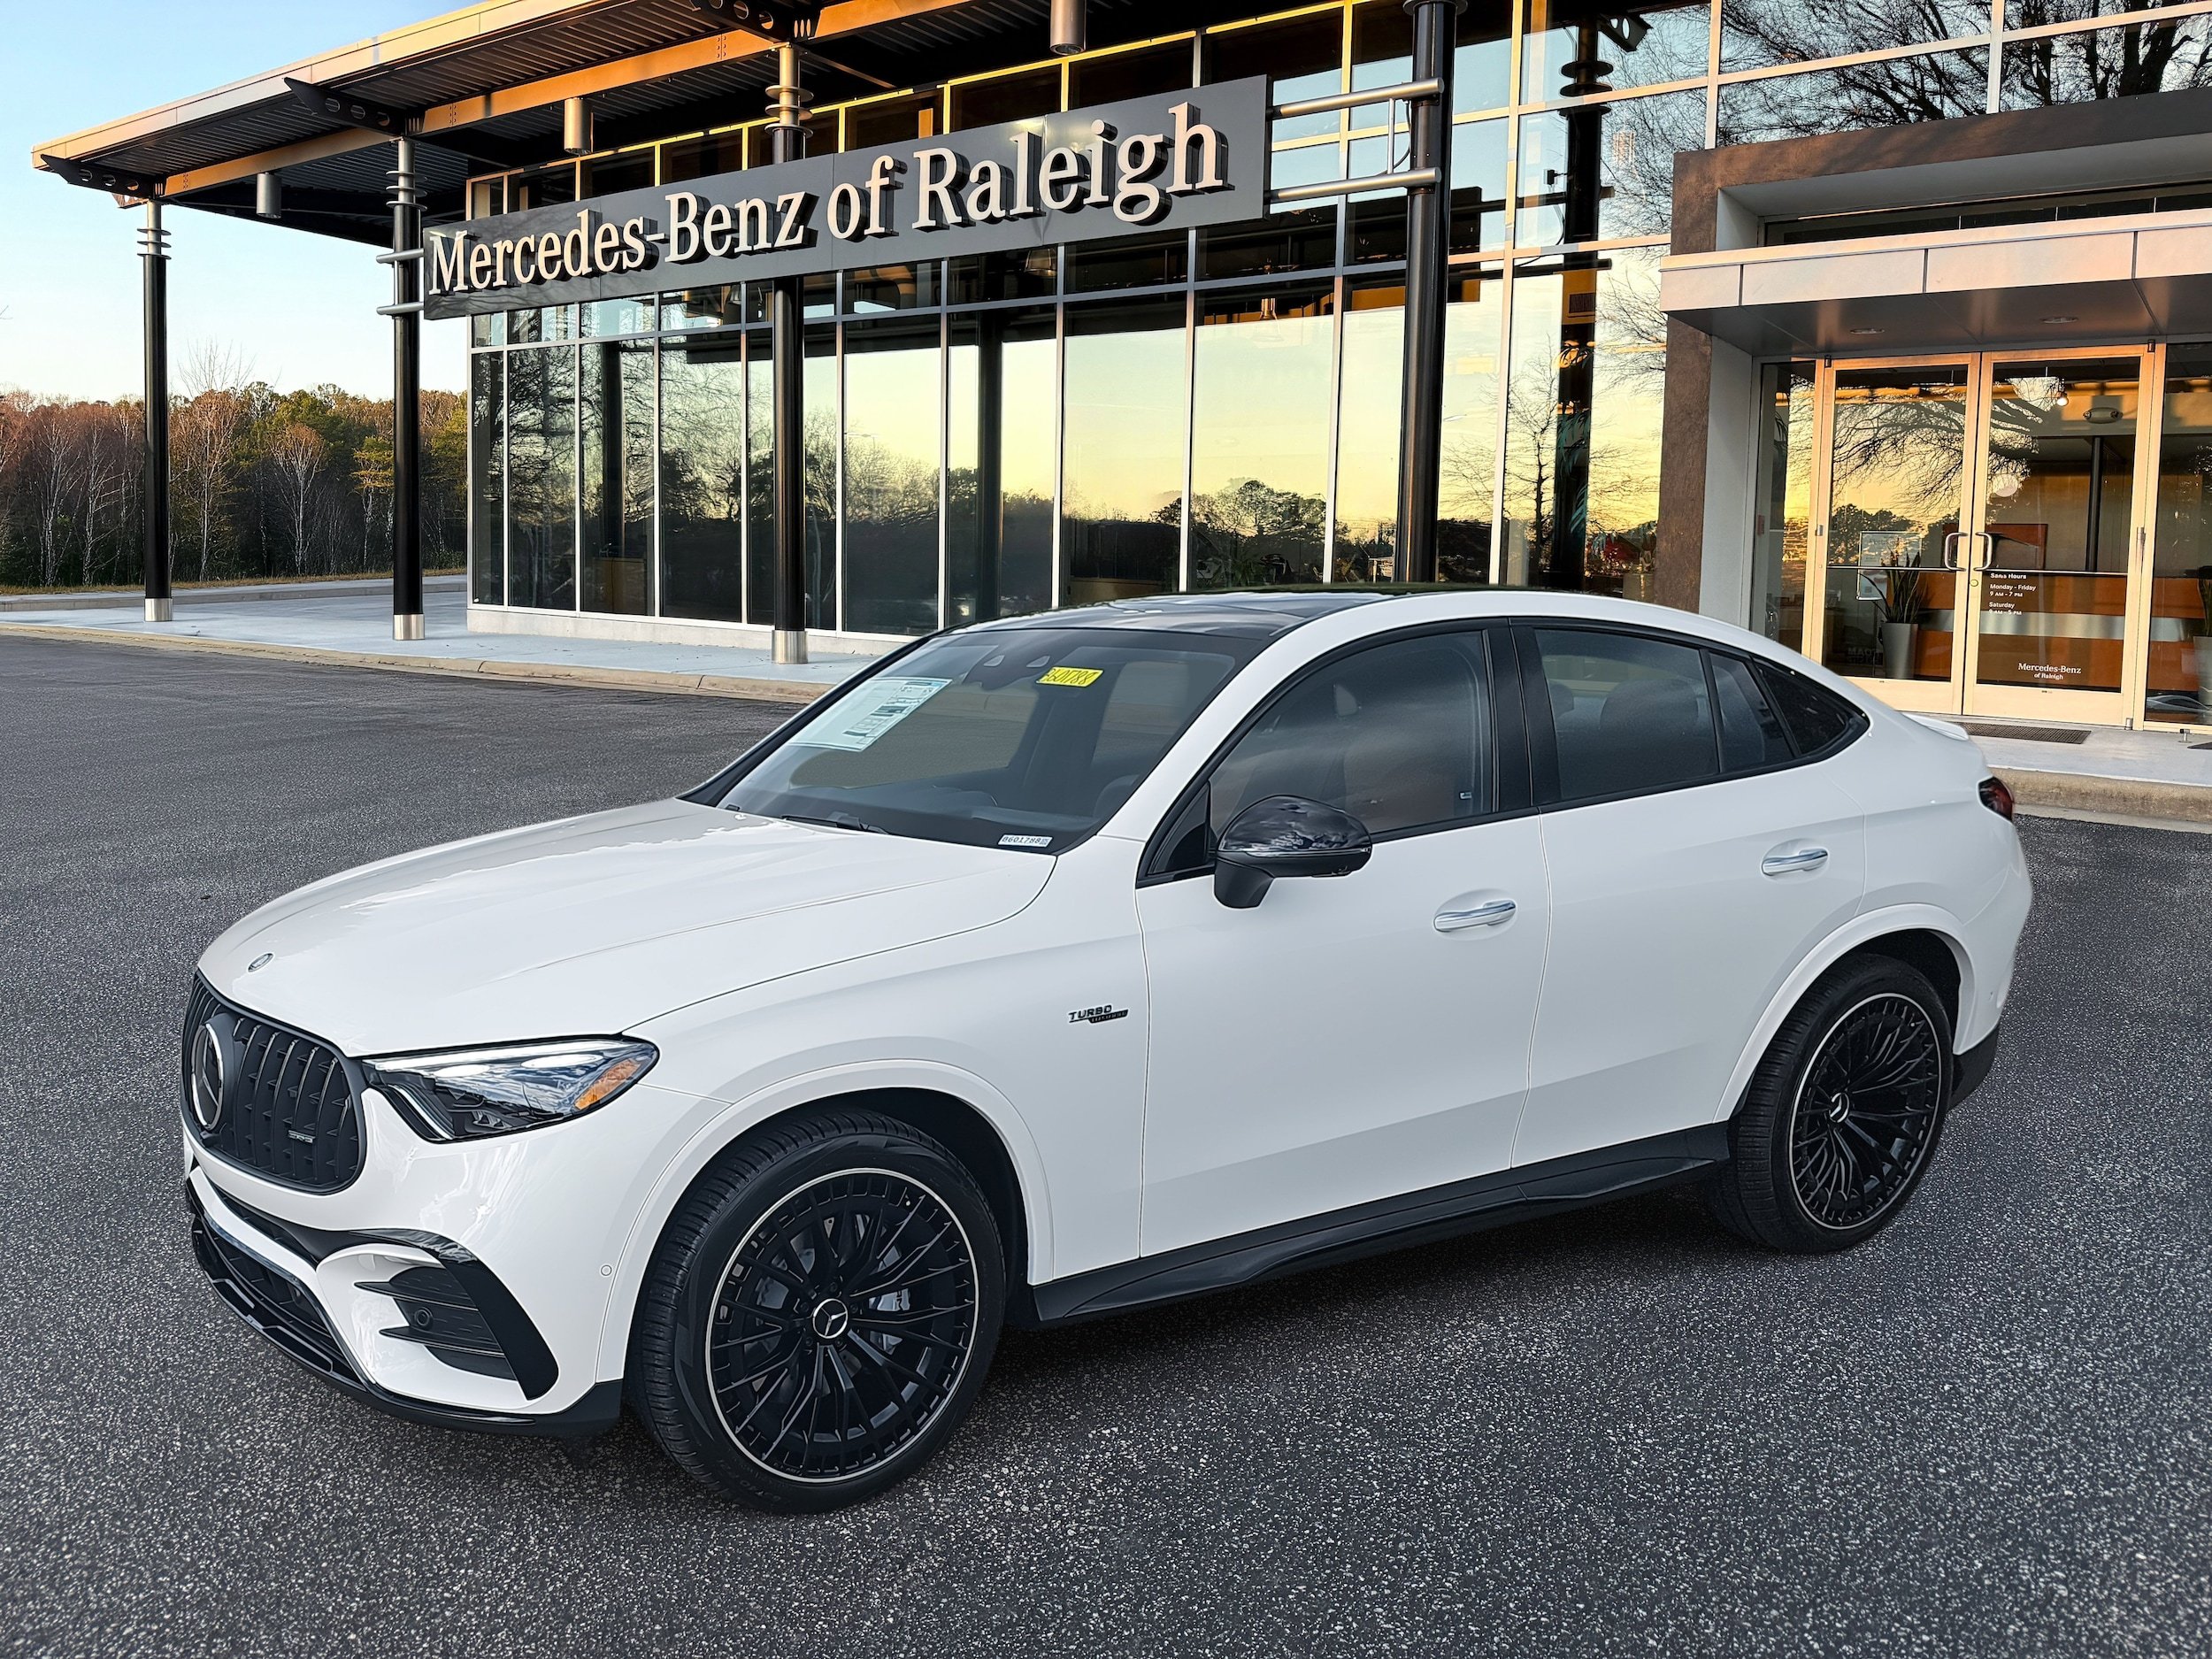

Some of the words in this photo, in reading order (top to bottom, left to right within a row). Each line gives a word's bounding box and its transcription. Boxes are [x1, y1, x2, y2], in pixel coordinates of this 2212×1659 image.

[428, 191, 807, 296] Mercedes-Benz
[826, 155, 895, 240] of
[912, 101, 1224, 223] Raleigh
[2017, 662, 2082, 674] Mercedes-Benz
[1067, 1004, 1112, 1020] TURBO
